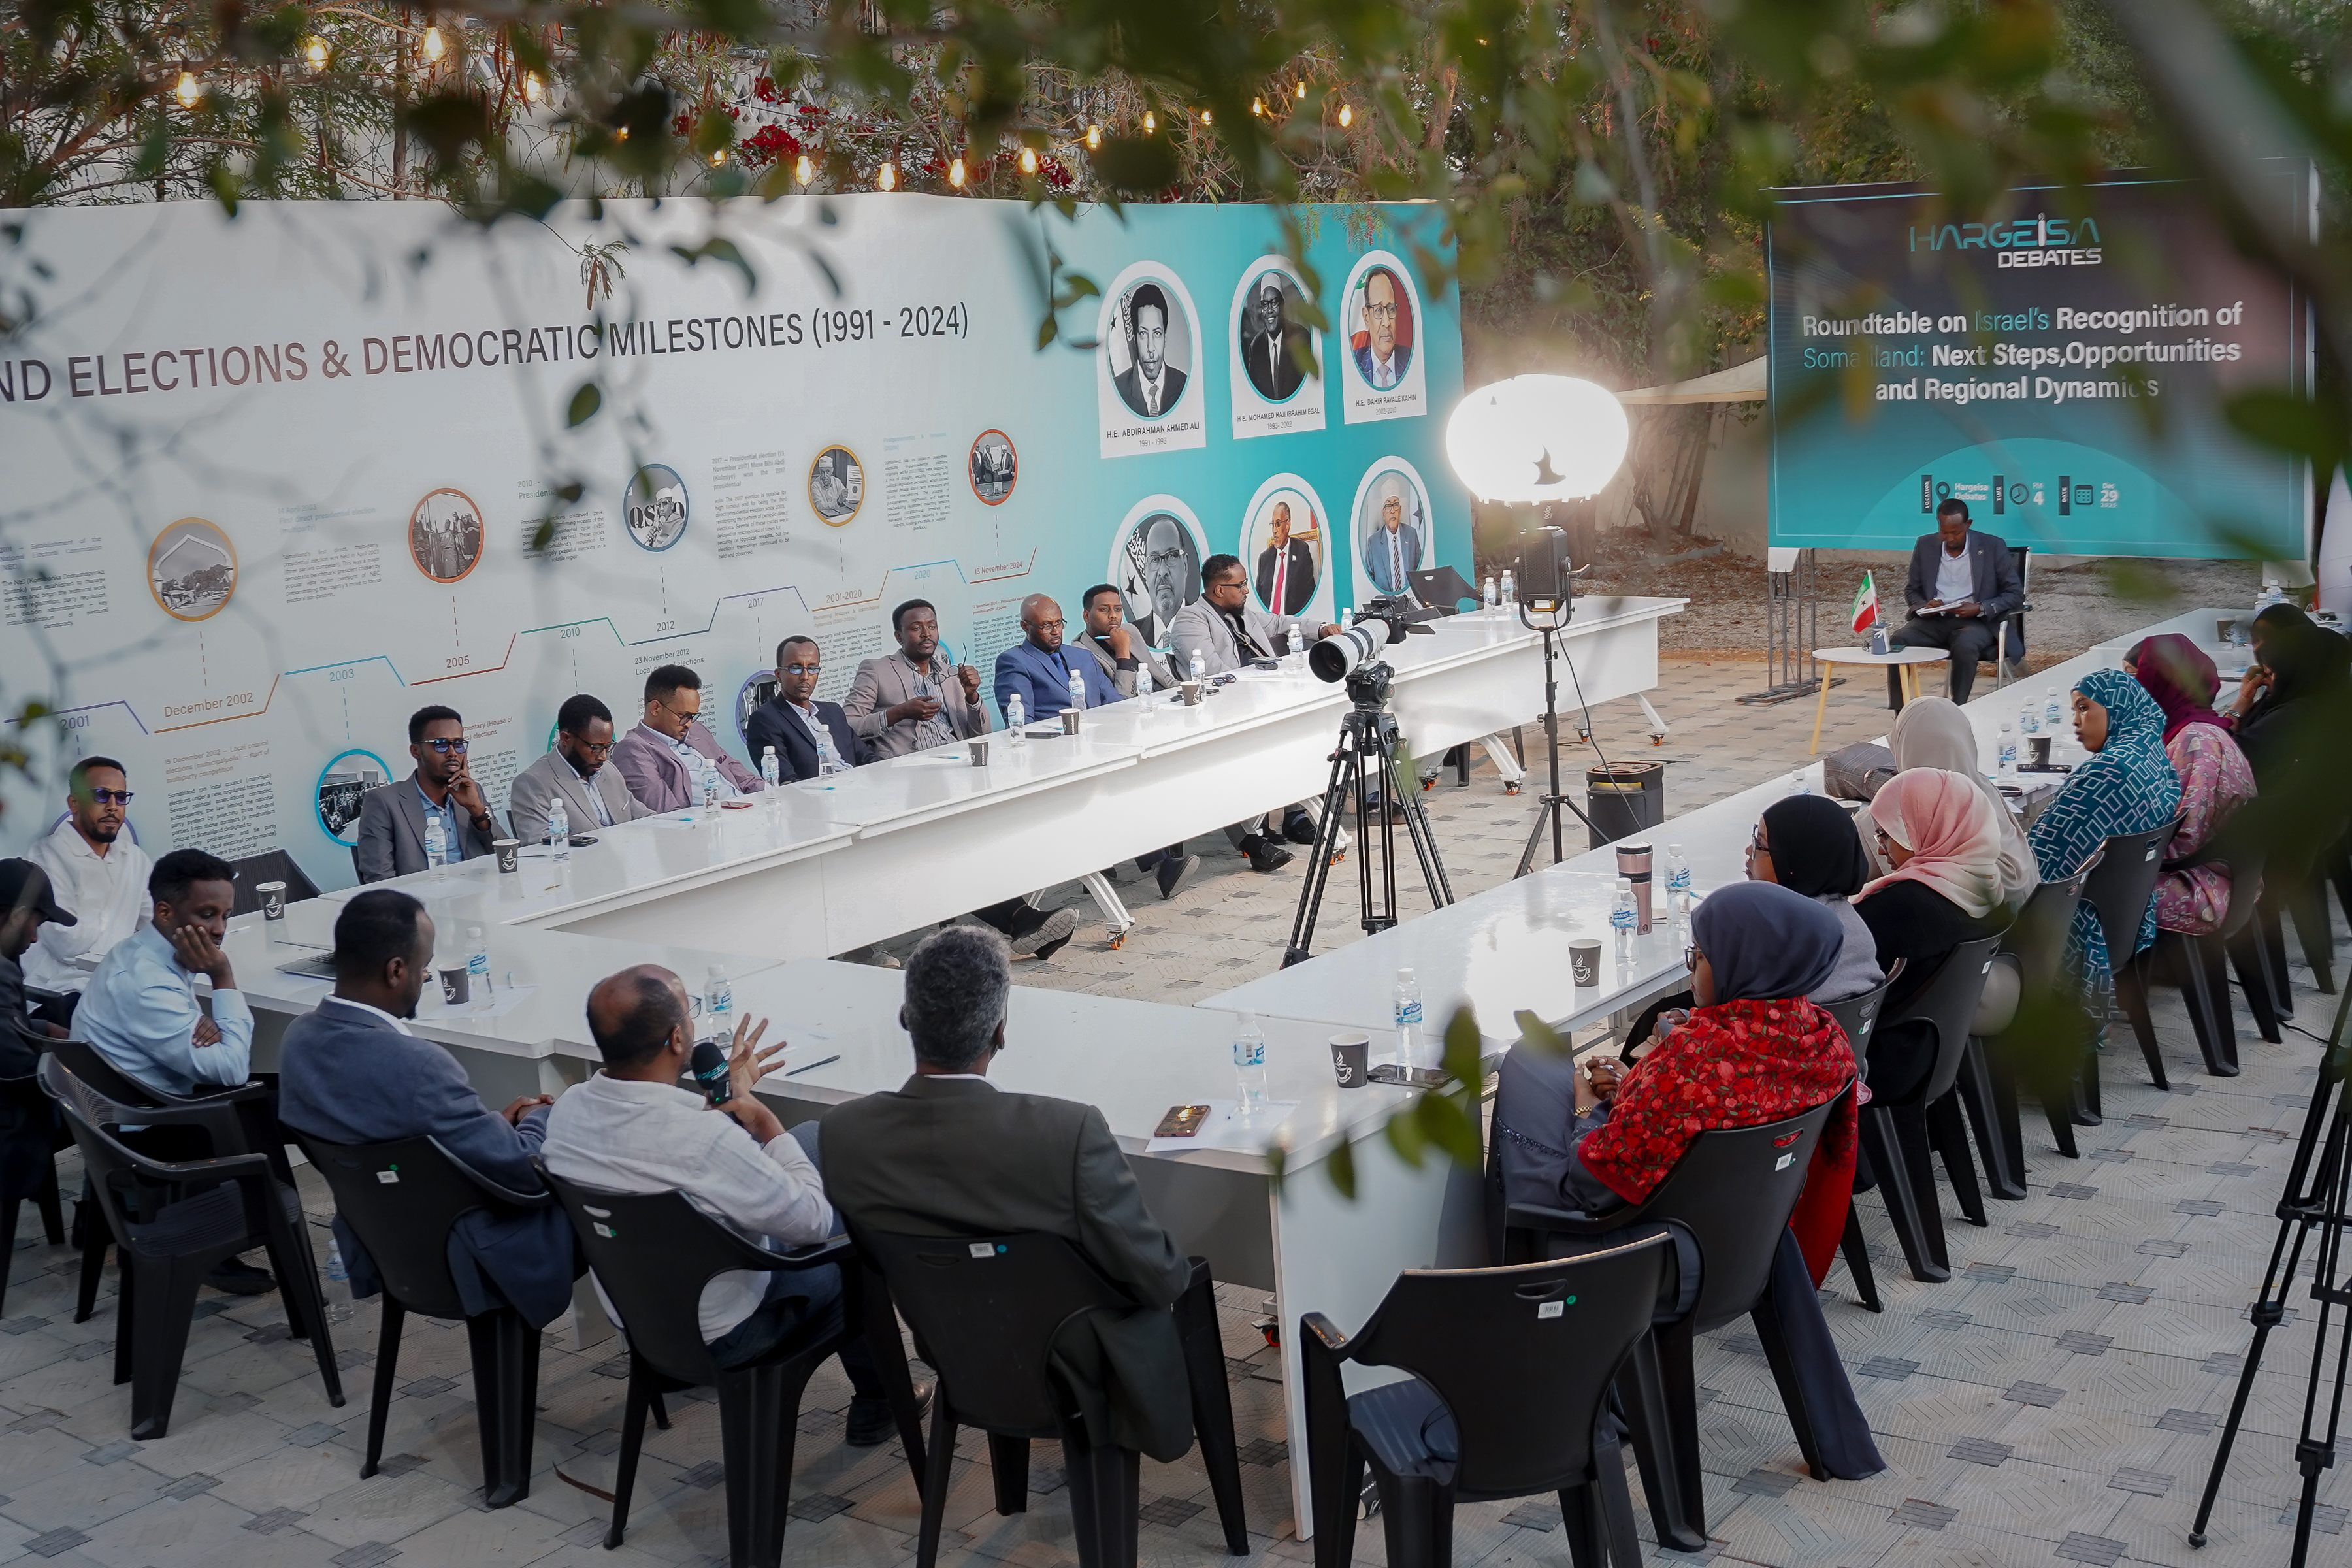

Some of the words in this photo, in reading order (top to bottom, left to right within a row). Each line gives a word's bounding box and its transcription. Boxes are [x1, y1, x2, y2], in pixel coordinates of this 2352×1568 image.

[1910, 212, 2100, 252] HARGEISA
[1997, 248, 2102, 268] DEBATES
[1803, 310, 1933, 336] Roundtable
[1938, 314, 1967, 332] on
[2057, 303, 2210, 334] Recognition
[2215, 301, 2243, 325] of
[68, 342, 308, 397] ELECTIONS
[322, 340, 351, 378] &
[363, 324, 600, 375] DEMOCRATIC
[608, 313, 803, 357] MILESTONES
[813, 308, 874, 348] (1991
[899, 301, 968, 339] 2024)
[1932, 344, 1987, 366] Next
[1876, 377, 1918, 400] and
[1925, 376, 2028, 405] Regional
[1249, 412, 1275, 421] MOHAMED
[1276, 410, 1286, 419] HAJI
[1107, 430, 1119, 438] H.E.
[1122, 425, 1165, 437] ABDIRAHMAN
[1167, 423, 1188, 432] AHMED
[1190, 421, 1200, 430] ALI
[1155, 437, 1167, 446] 1993
[1954, 482, 1989, 492] Hargeisa
[1954, 491, 1988, 500] Debates
[2033, 491, 2044, 506] 4
[2100, 490, 2119, 502] 29
[982, 564, 1009, 574] November
[1010, 561, 1022, 570] 2024
[915, 569, 930, 580] 2020
[747, 597, 764, 608] 2017
[826, 589, 862, 603] 2001-2020
[561, 627, 580, 639] 2010
[657, 621, 675, 632] 2012
[446, 655, 470, 668] 2005
[644, 652, 675, 662] November
[676, 648, 689, 657] 2012
[329, 668, 354, 682] 2003
[636, 666, 652, 675] Local
[164, 698, 223, 717] December
[226, 692, 253, 706] 2002
[59, 715, 90, 730] 2001
[487, 719, 506, 728] (House
[473, 730, 497, 738] elections
[172, 753, 204, 763] December
